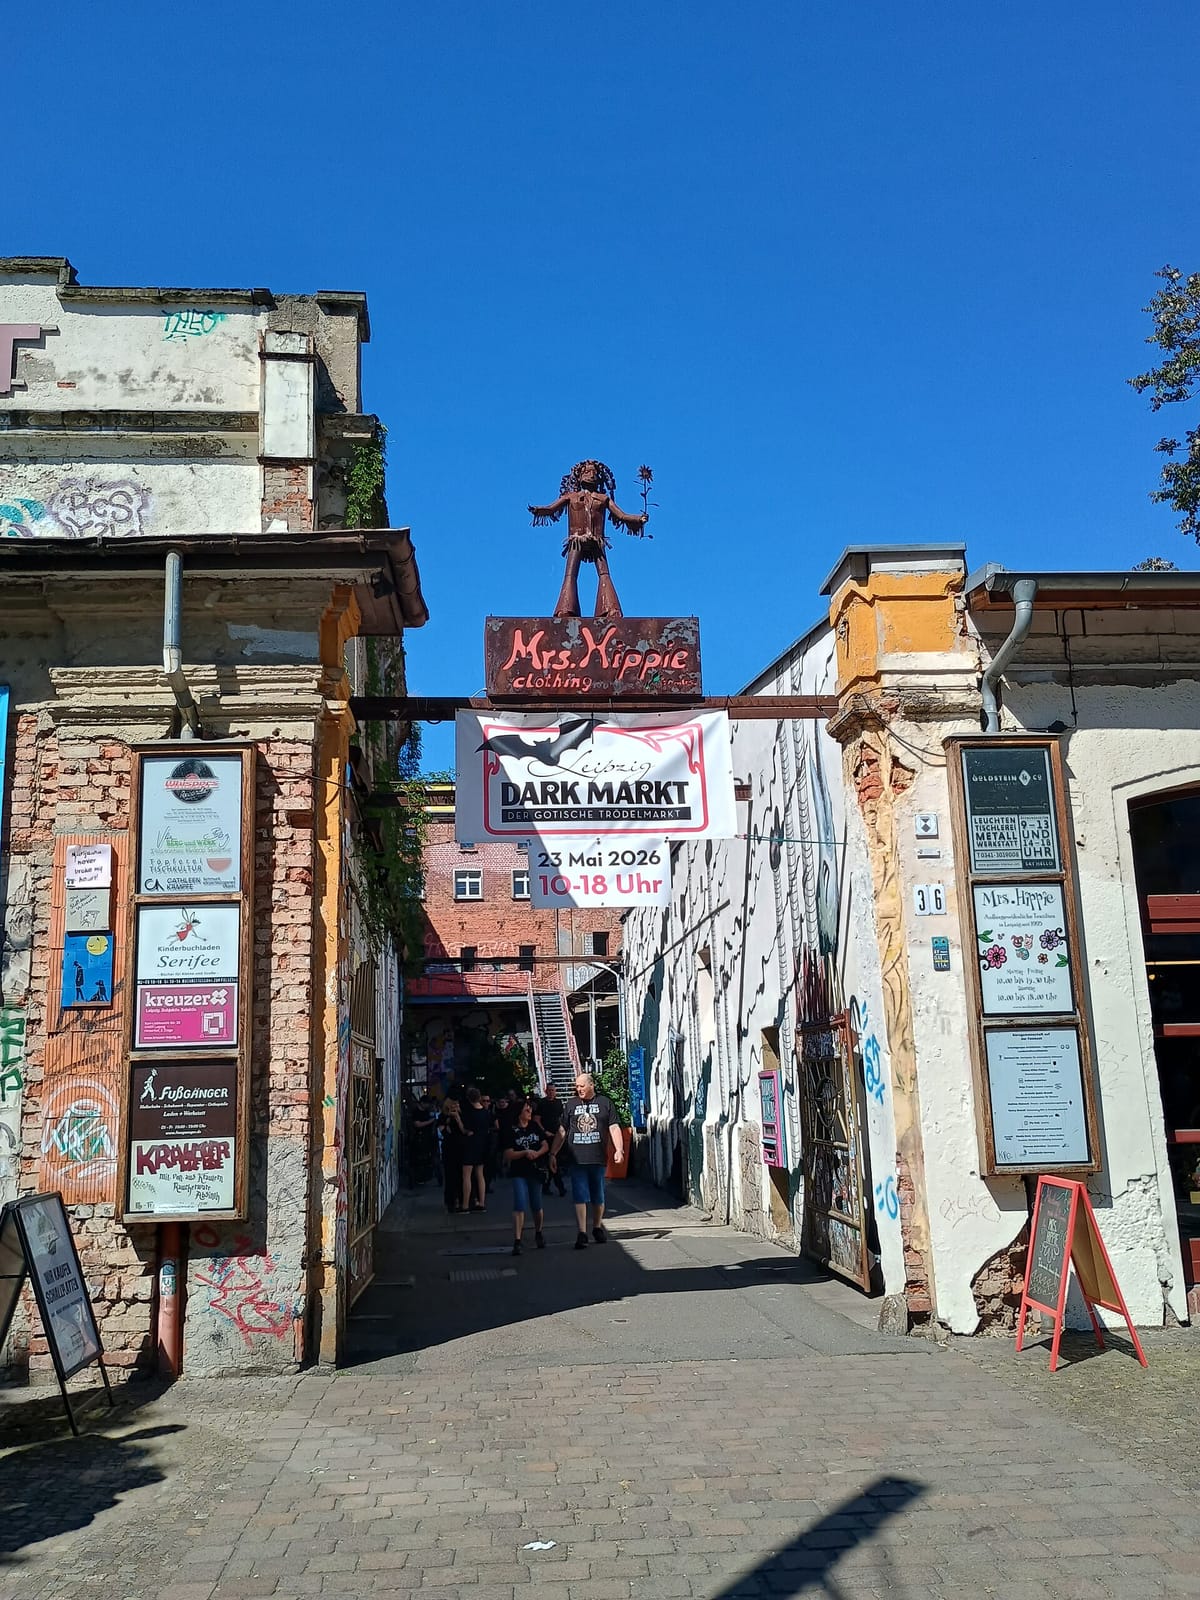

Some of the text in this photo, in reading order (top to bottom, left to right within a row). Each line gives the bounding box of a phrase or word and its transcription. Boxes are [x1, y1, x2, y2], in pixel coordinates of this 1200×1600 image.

[512, 673, 592, 691] clothing
[527, 750, 654, 787] Leipzig
[501, 780, 690, 806] DARK MARKT
[507, 808, 681, 820] DER GOTISCHE TRÖDELMARKT
[974, 817, 1016, 825] LEUCHTEN
[976, 832, 1018, 841] METALL
[1022, 830, 1050, 839] UND
[537, 850, 661, 868] 23 Mai 2026
[1024, 847, 1052, 858] UHR
[538, 873, 663, 896] 10-18 Uhr
[917, 888, 942, 911] 36
[157, 944, 221, 952] Kinderbuchladen
[156, 954, 221, 970] Serifee
[144, 991, 211, 1007] kreuzer
